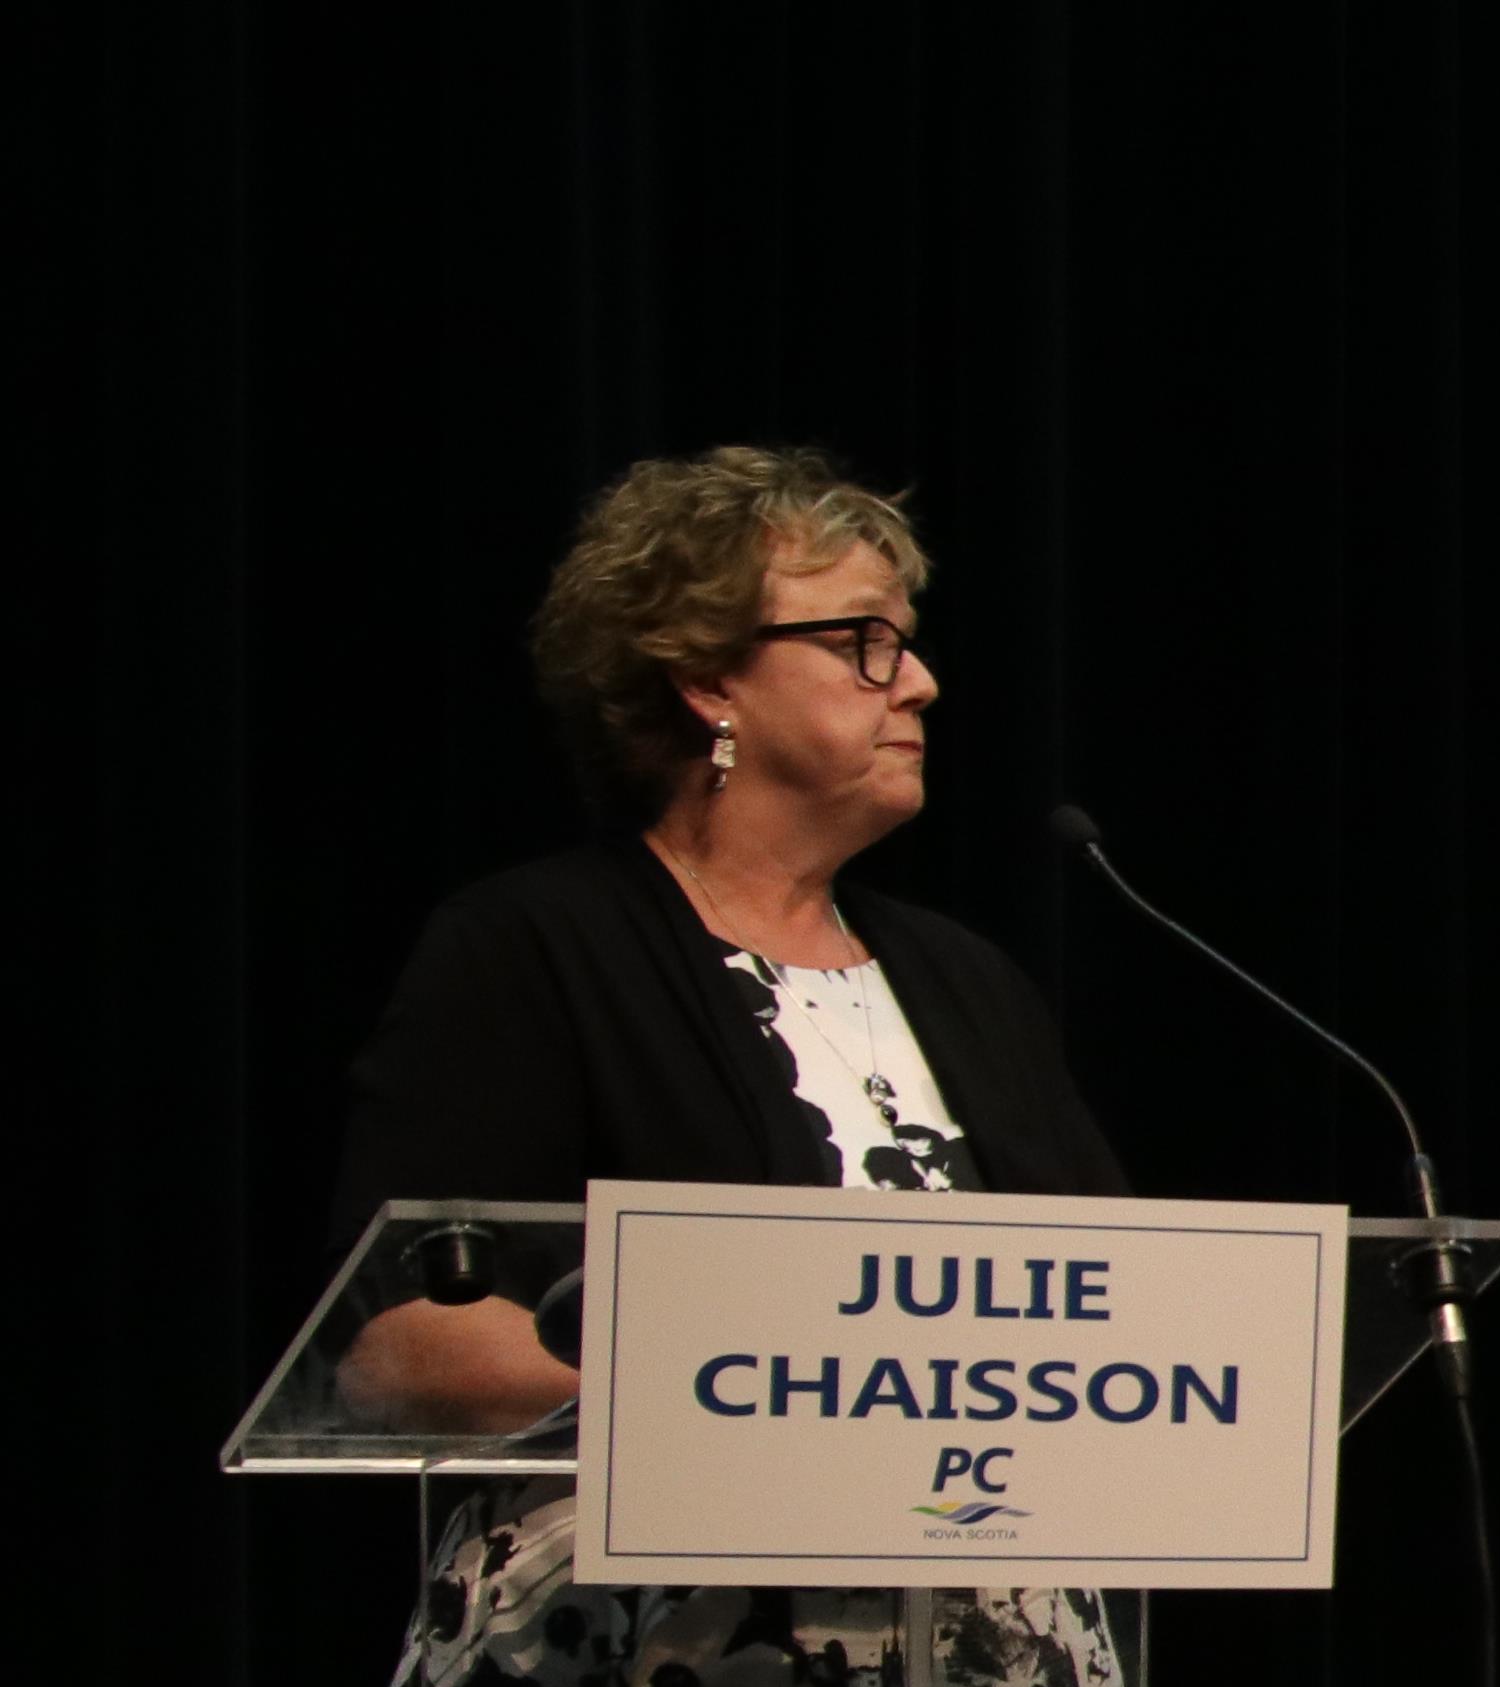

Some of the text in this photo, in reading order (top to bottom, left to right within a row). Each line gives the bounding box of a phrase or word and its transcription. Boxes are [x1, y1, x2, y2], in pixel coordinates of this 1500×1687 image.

[837, 1253, 1111, 1322] JULIE
[692, 1352, 1240, 1426] CHAISSON
[931, 1446, 1015, 1495] PC
[923, 1528, 1018, 1541] NOVA SCOTIA
